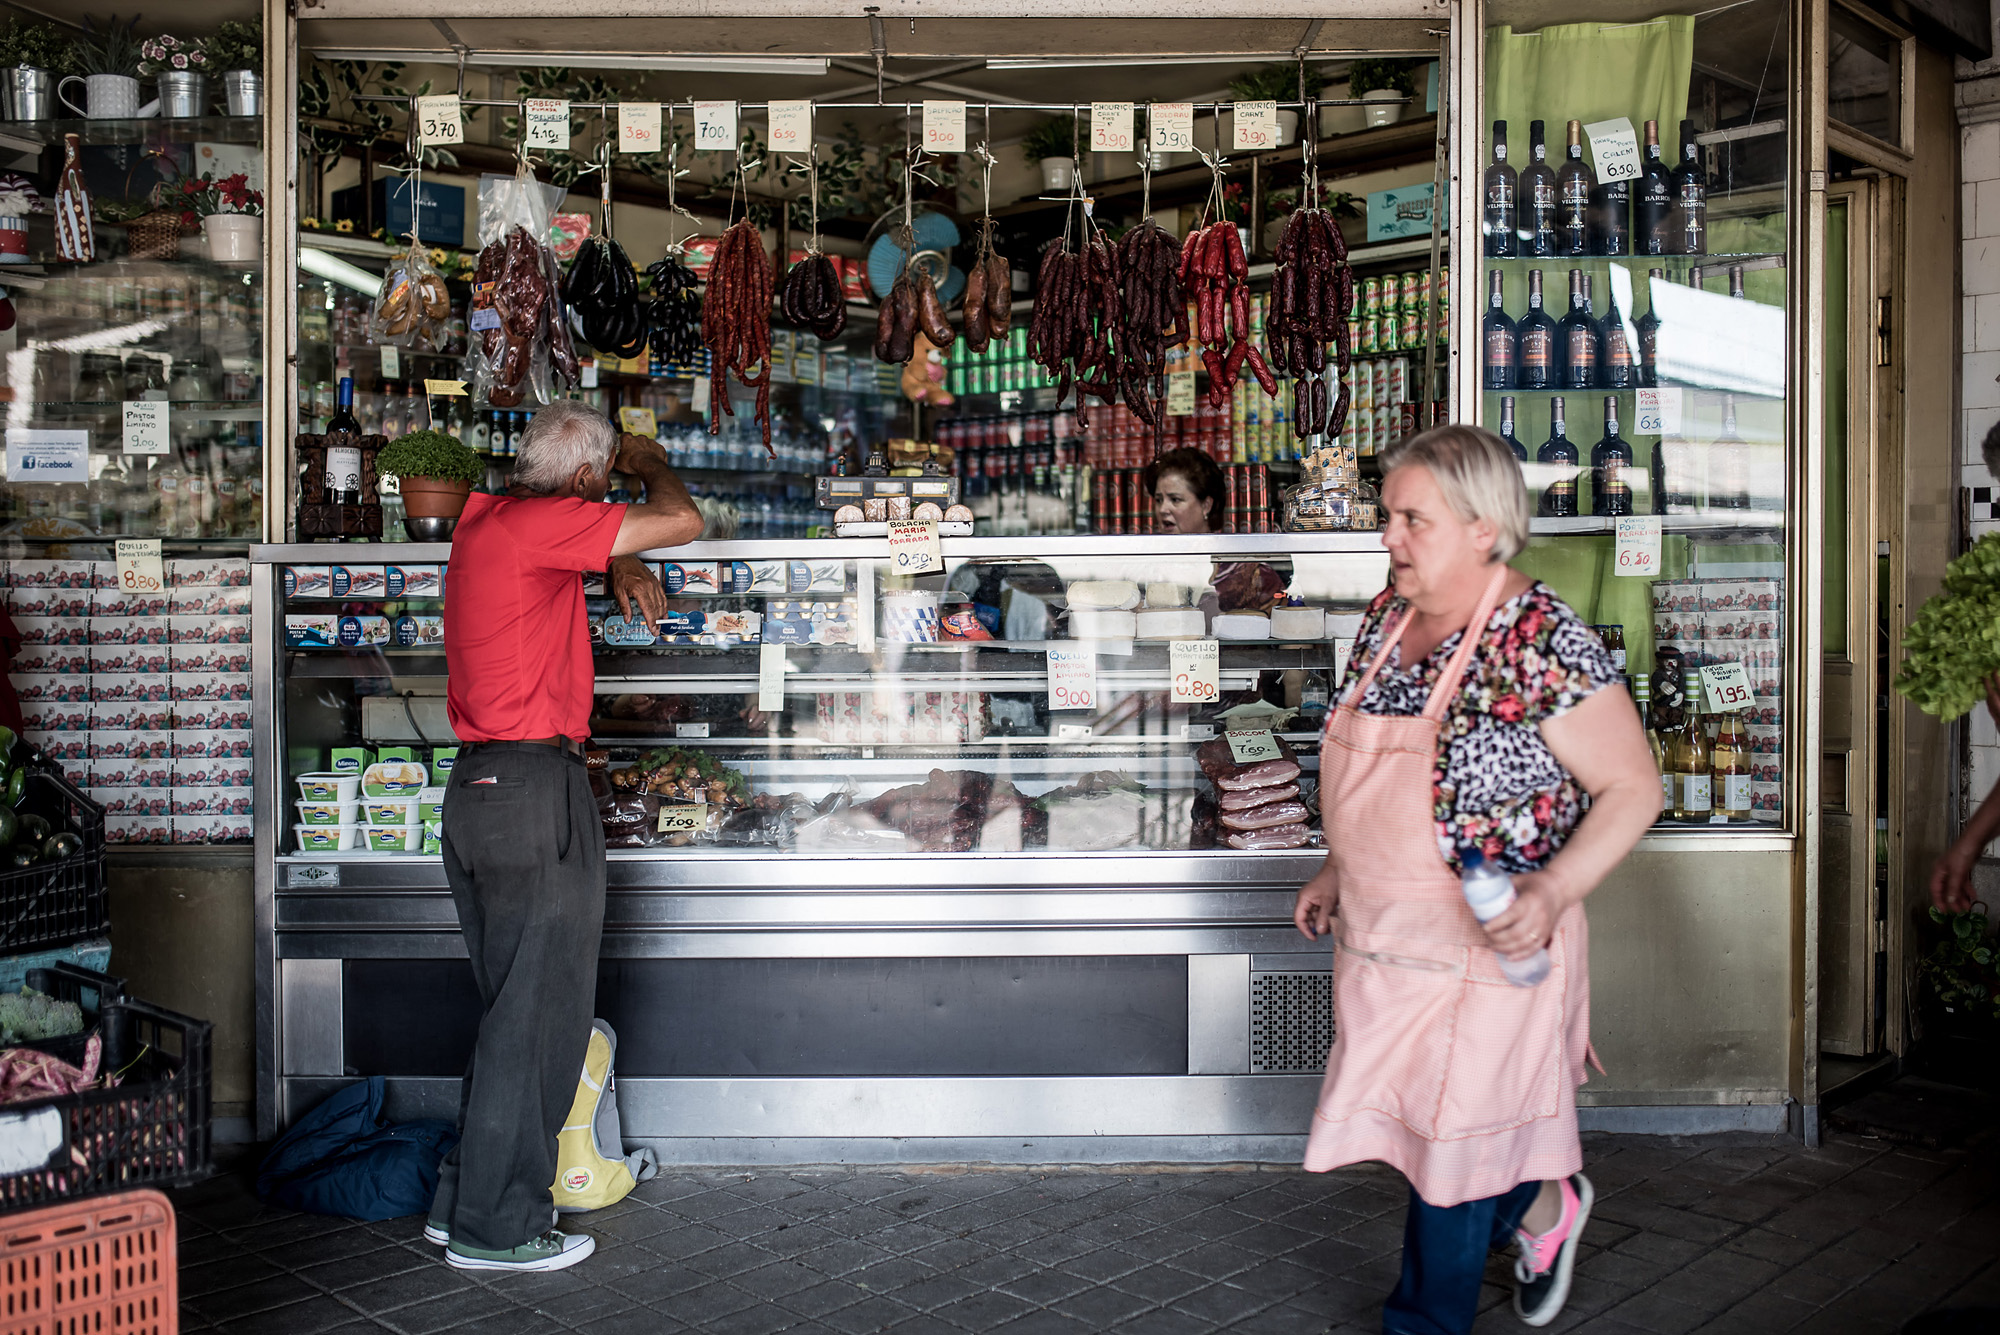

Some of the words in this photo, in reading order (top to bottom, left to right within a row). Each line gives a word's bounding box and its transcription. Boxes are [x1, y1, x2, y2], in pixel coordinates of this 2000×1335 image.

[126, 411, 156, 419] PASTOR
[37, 460, 73, 469] facebook
[889, 520, 931, 528] BOLACHA
[894, 527, 927, 535] MARIA
[889, 536, 930, 546] TORRADA
[1175, 643, 1217, 652] QUEIJO
[1227, 729, 1267, 738] BACON
[569, 1176, 588, 1184] Lipton
